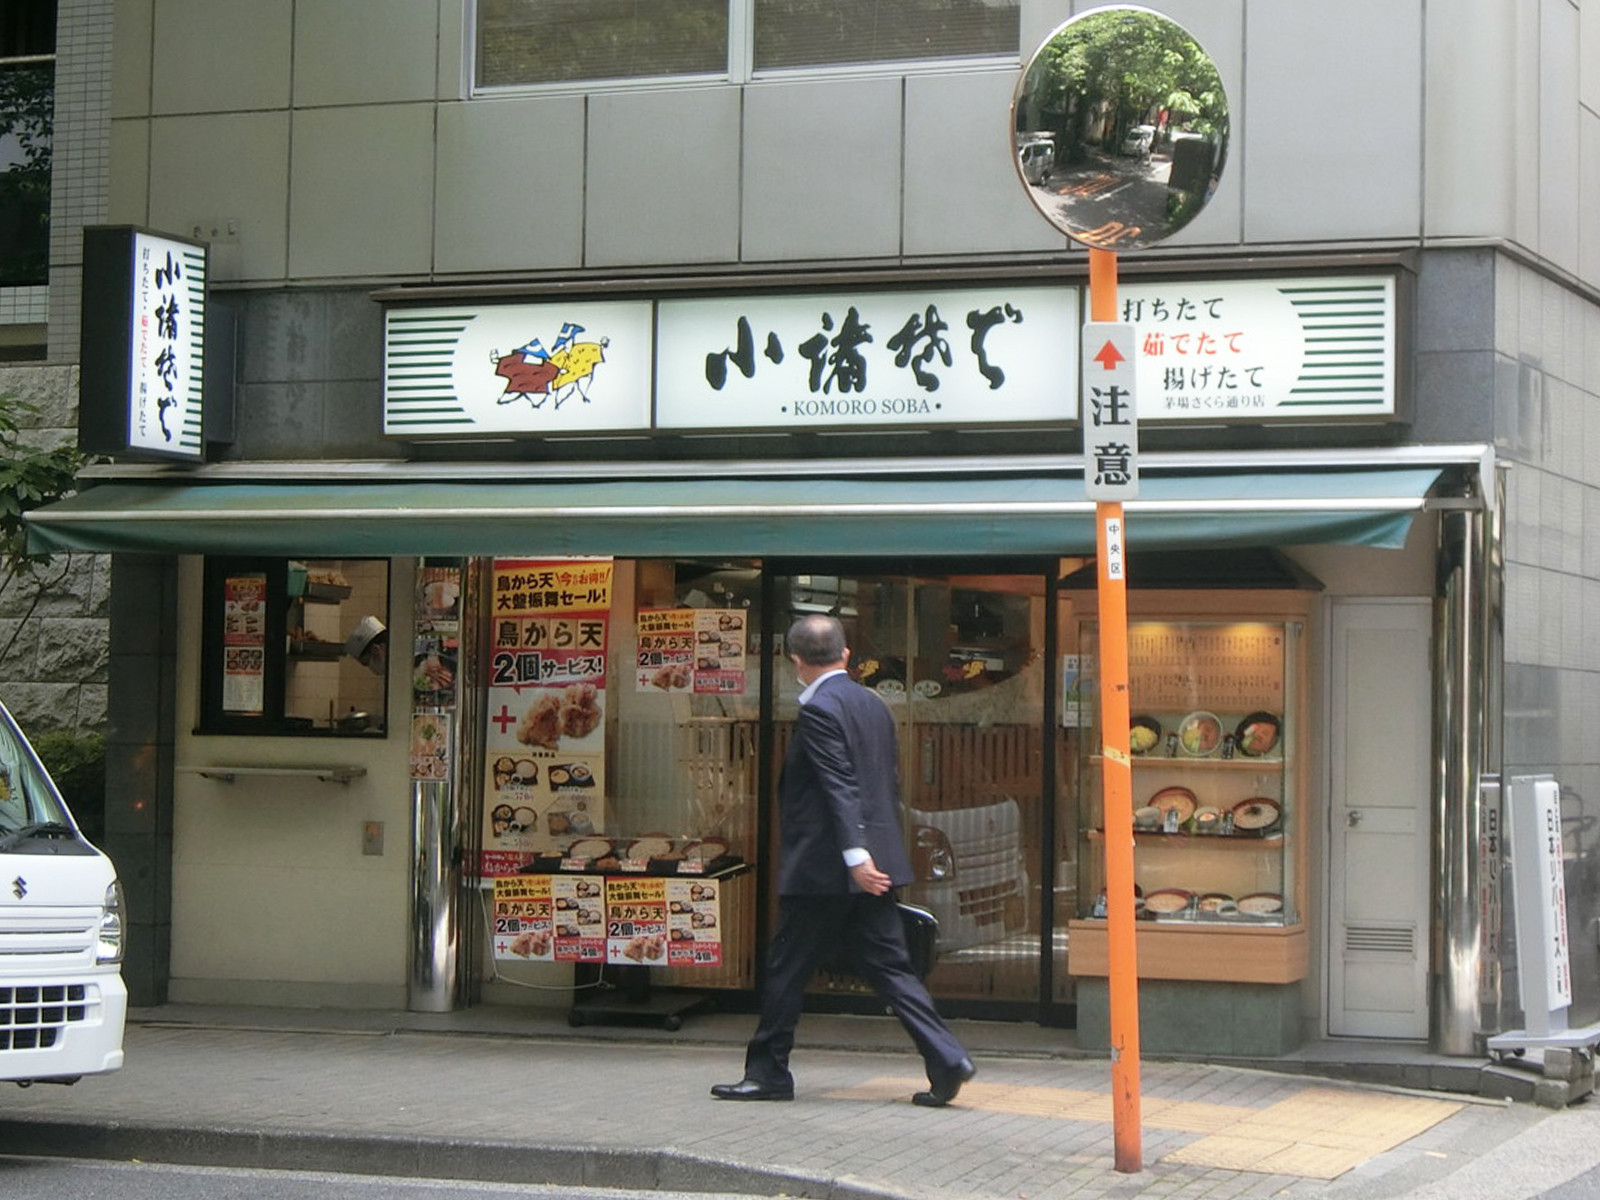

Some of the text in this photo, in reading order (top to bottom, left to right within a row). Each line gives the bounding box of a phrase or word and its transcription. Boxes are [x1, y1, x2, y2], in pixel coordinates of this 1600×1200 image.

[1122, 297, 1224, 322] 打ちたて
[1143, 332, 1244, 356] 茹でたて
[1163, 366, 1264, 390] 揚げたて
[794, 398, 931, 416] KOMORO SOBA
[1165, 395, 1265, 409] 茅場さくら通り店
[1090, 385, 1131, 486] 注意
[1109, 524, 1120, 573] 中央区
[497, 572, 553, 591] 鳥から天
[497, 588, 606, 610] 大盤振舞セール!
[497, 620, 602, 647] 鳥から天
